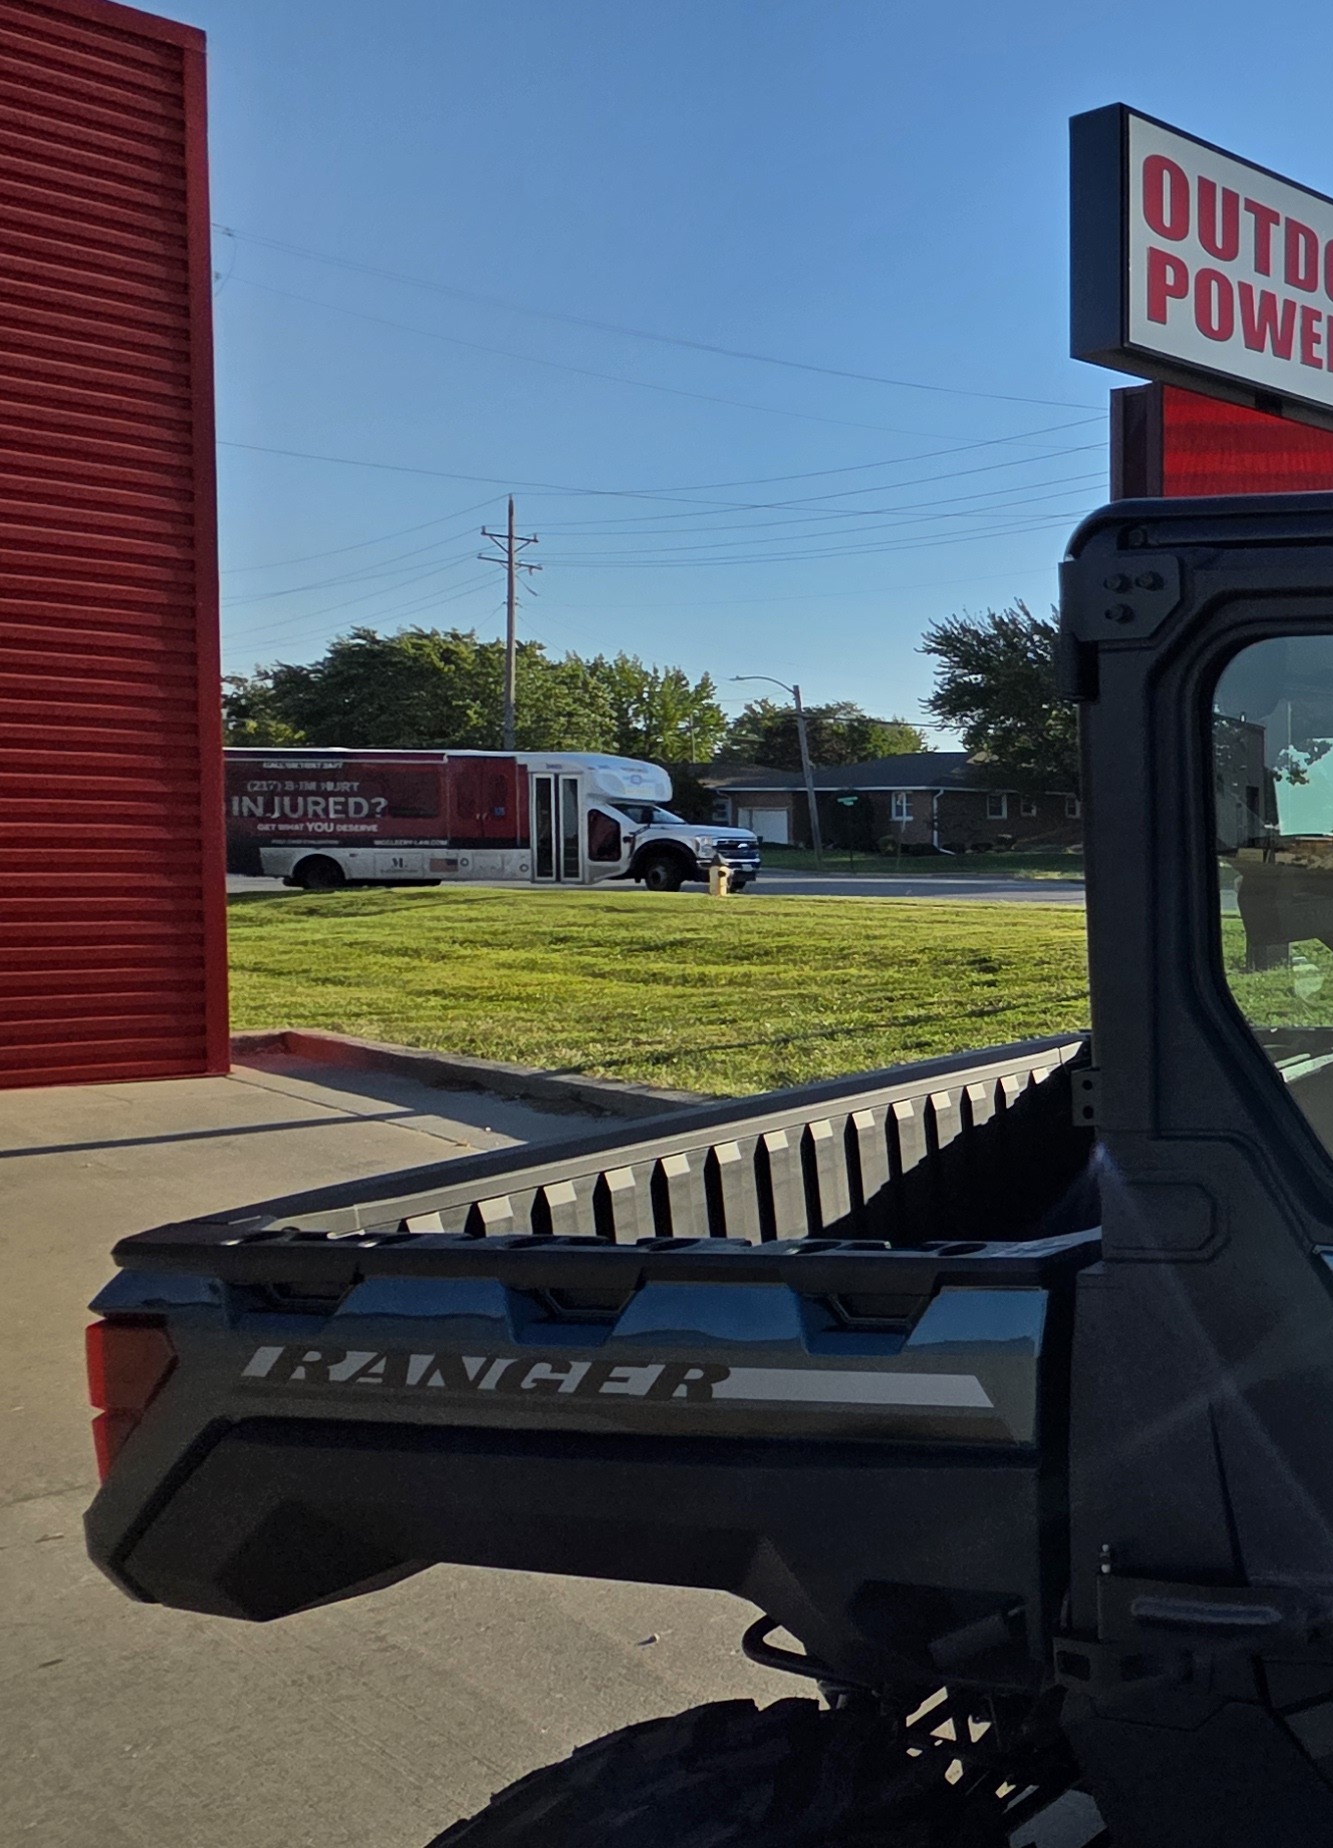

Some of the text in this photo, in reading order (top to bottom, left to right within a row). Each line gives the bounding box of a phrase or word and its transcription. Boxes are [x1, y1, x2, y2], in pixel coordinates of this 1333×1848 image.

[246, 780, 282, 792] (217)
[231, 796, 389, 819] INJURED?
[257, 822, 378, 833] GET WHAT YOU DESERVE
[262, 1345, 733, 1402] RANGER
